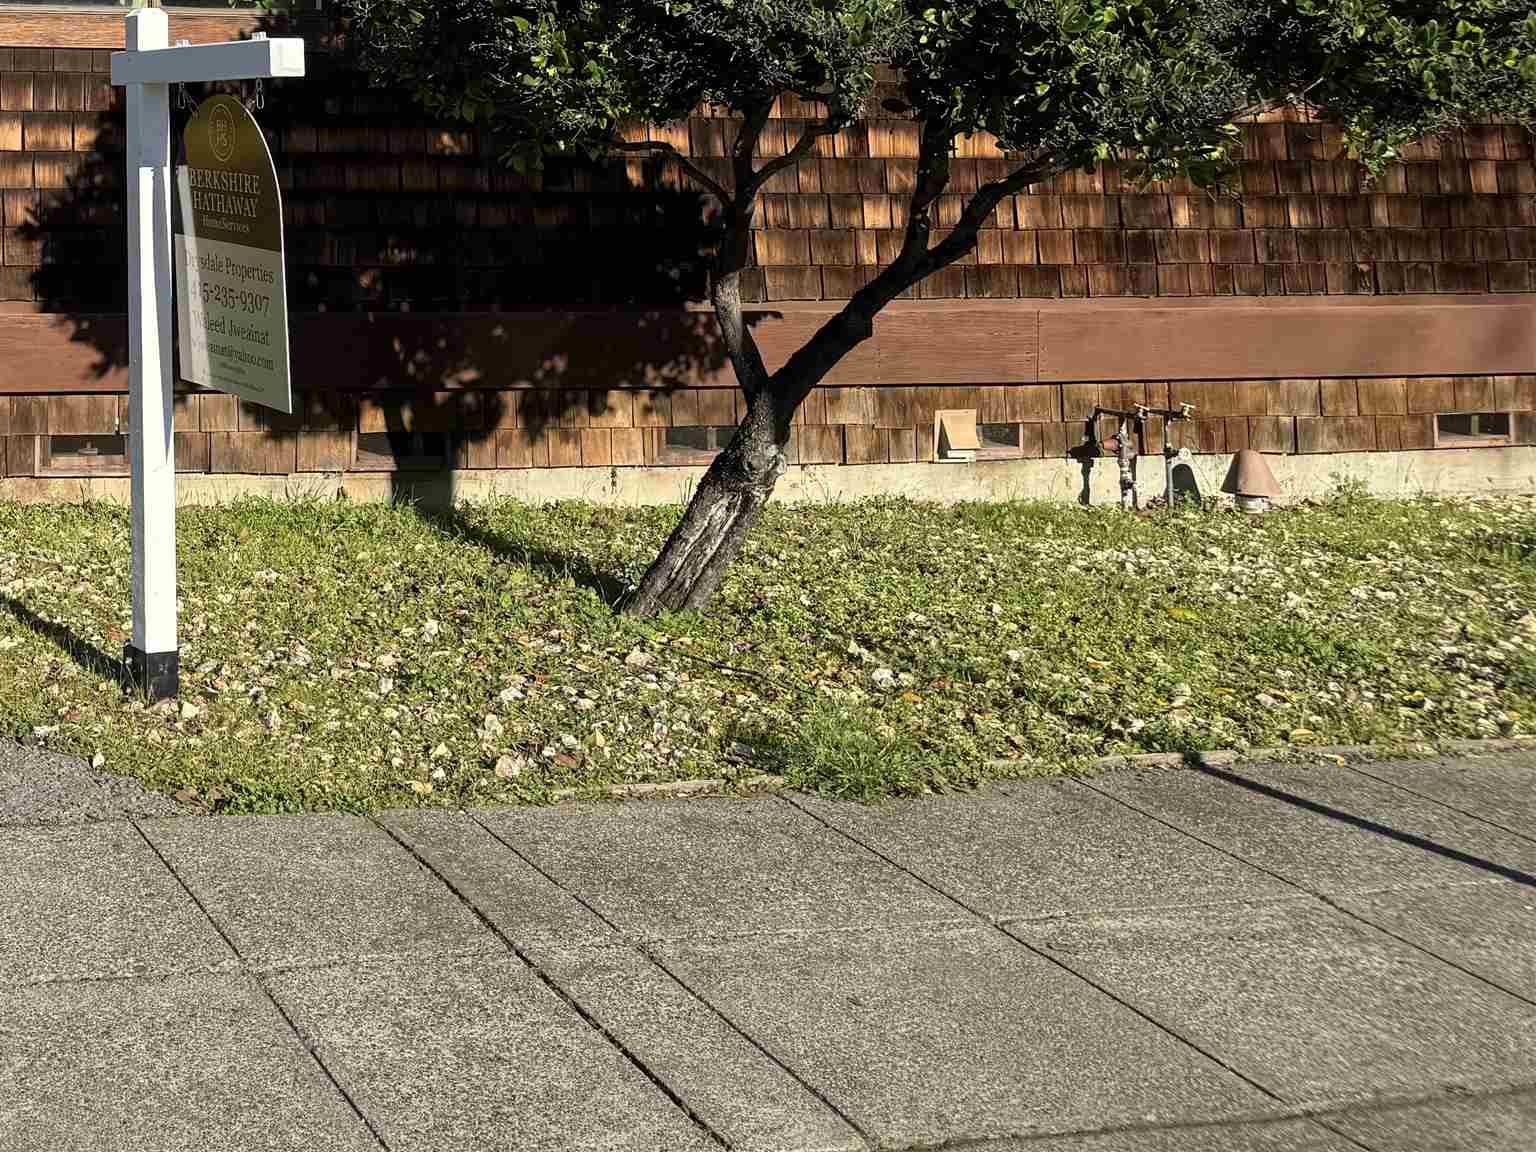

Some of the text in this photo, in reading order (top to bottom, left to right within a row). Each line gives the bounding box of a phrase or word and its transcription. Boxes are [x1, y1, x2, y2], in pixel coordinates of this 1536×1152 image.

[190, 168, 260, 194] BERKSHIRE
[193, 190, 257, 217] HATHAWAY
[225, 256, 275, 284] Properties
